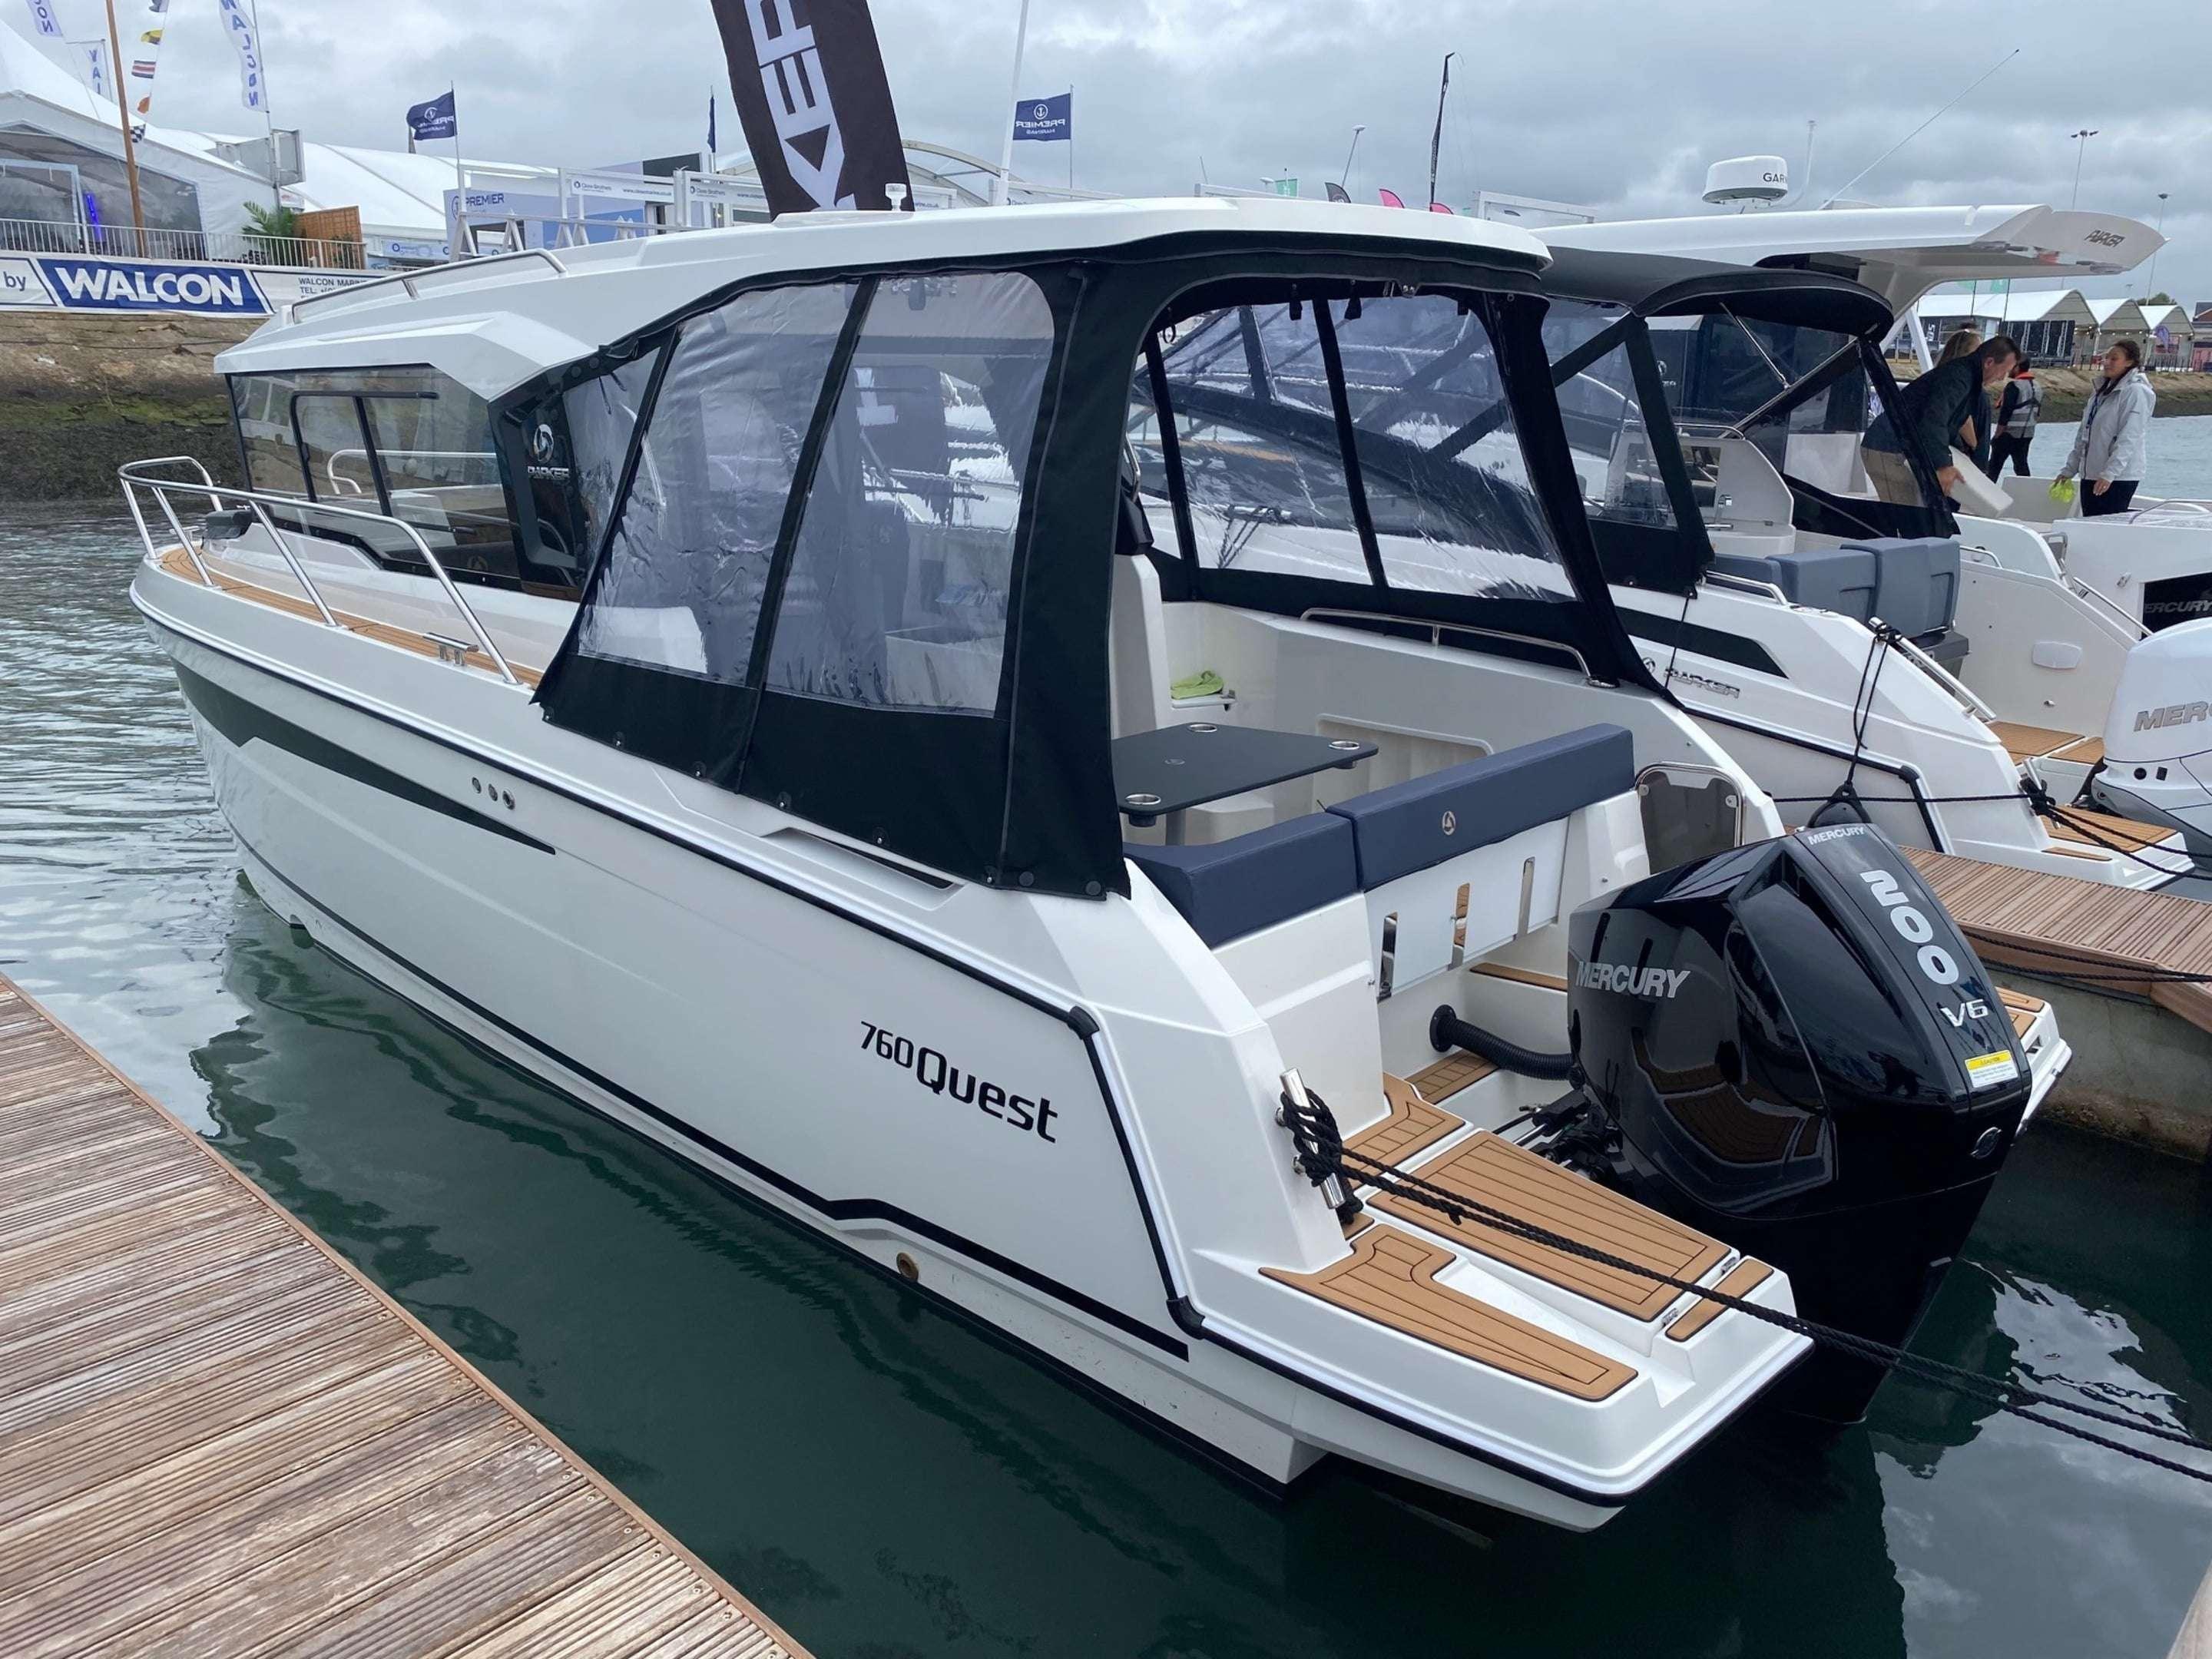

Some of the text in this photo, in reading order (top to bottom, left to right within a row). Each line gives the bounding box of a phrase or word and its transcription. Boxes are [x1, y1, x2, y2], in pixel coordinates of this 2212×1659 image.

[1763, 173, 1787, 184] GAR
[465, 193, 505, 207] PREMIER
[3, 271, 26, 292] by
[54, 267, 243, 306] WALCON
[299, 277, 334, 286] WALCON
[2133, 700, 2212, 732] MER
[1807, 826, 1866, 846] MERCURY
[1859, 869, 1959, 985] 200
[1575, 961, 1691, 998] MERCURY
[1939, 998, 1988, 1027] V6
